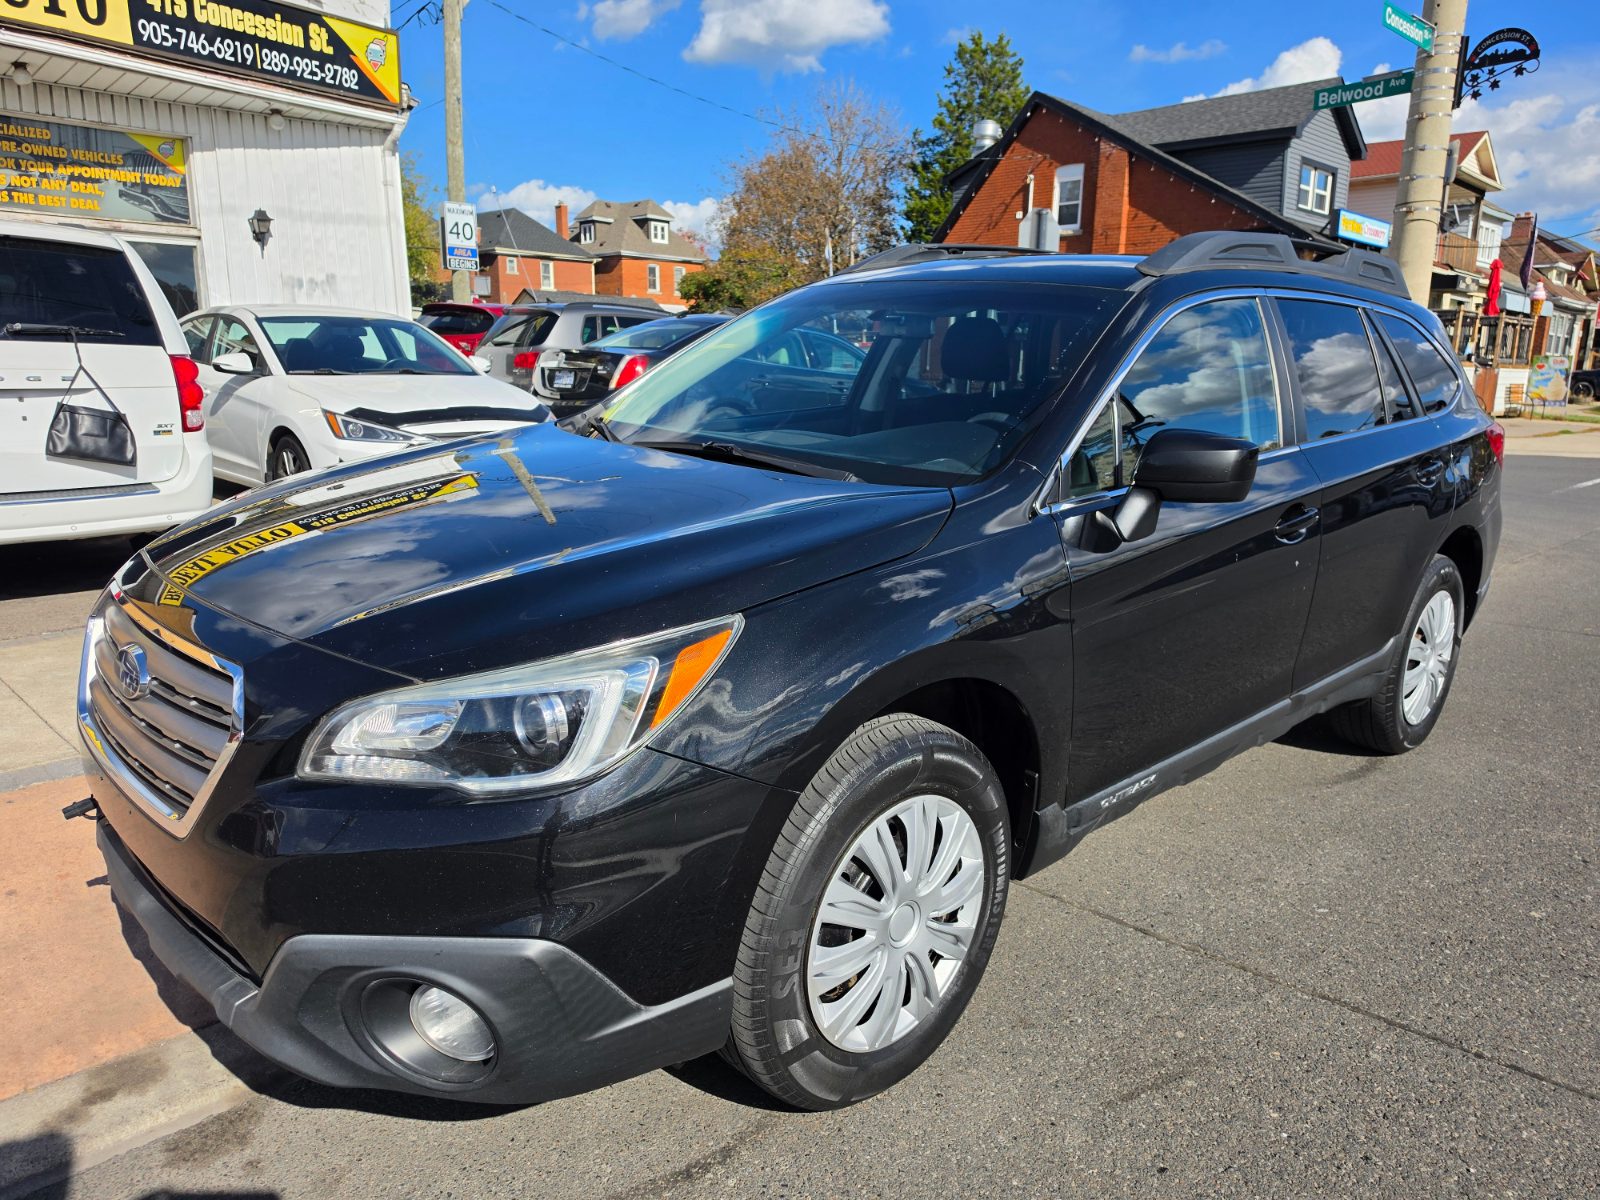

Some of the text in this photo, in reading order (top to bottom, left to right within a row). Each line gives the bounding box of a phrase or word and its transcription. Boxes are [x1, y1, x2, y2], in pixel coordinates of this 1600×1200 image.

[193, 0, 304, 48] Concession
[308, 22, 333, 55] St.
[1385, 6, 1423, 43] Concession
[1477, 31, 1521, 52] CONCESSION
[1317, 78, 1406, 107] Belwood Ave
[0, 140, 124, 165] RE-OWNED VEHICLES
[19, 159, 54, 173] YOUR
[57, 163, 141, 183] APPOINTMENT
[144, 173, 182, 187] TODAY
[10, 175, 37, 188] NOT
[41, 178, 67, 191] ANY
[70, 181, 105, 198] DEAL,
[11, 191, 35, 205] THE
[38, 194, 67, 207] BEST
[70, 197, 101, 211] DEAL
[449, 221, 473, 241] 40
[450, 258, 477, 270] BEGINS
